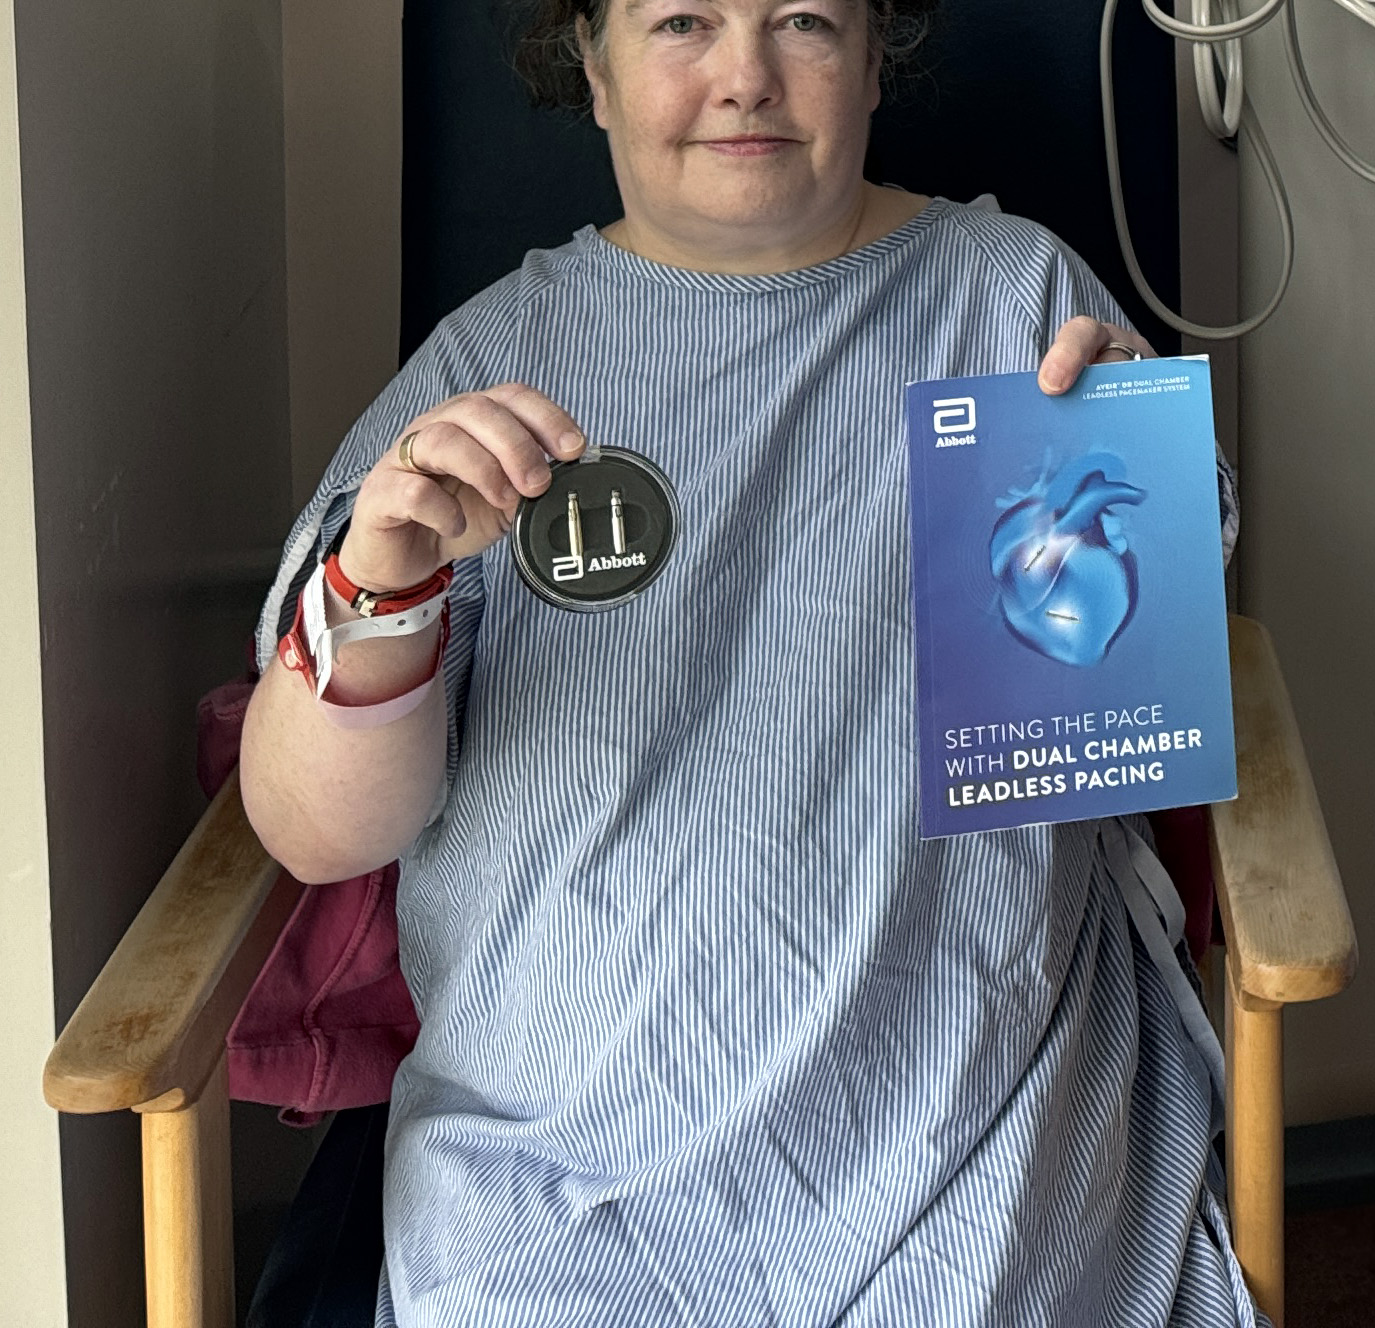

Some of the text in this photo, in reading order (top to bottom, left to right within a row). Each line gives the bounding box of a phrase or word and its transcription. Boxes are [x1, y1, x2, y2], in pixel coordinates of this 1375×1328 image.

[1082, 383, 1190, 400] LEADLESS PACEMAKER SYSTEM
[1133, 379, 1153, 388] DUAL
[1154, 375, 1190, 386] CHAMBER
[935, 434, 976, 448] Abbott
[588, 552, 647, 573] Abbott
[945, 704, 1164, 750] SETTING THE PACE
[945, 728, 1202, 778] WITH DUAL CHAMBER
[948, 762, 1164, 807] LEADLESS PACING
